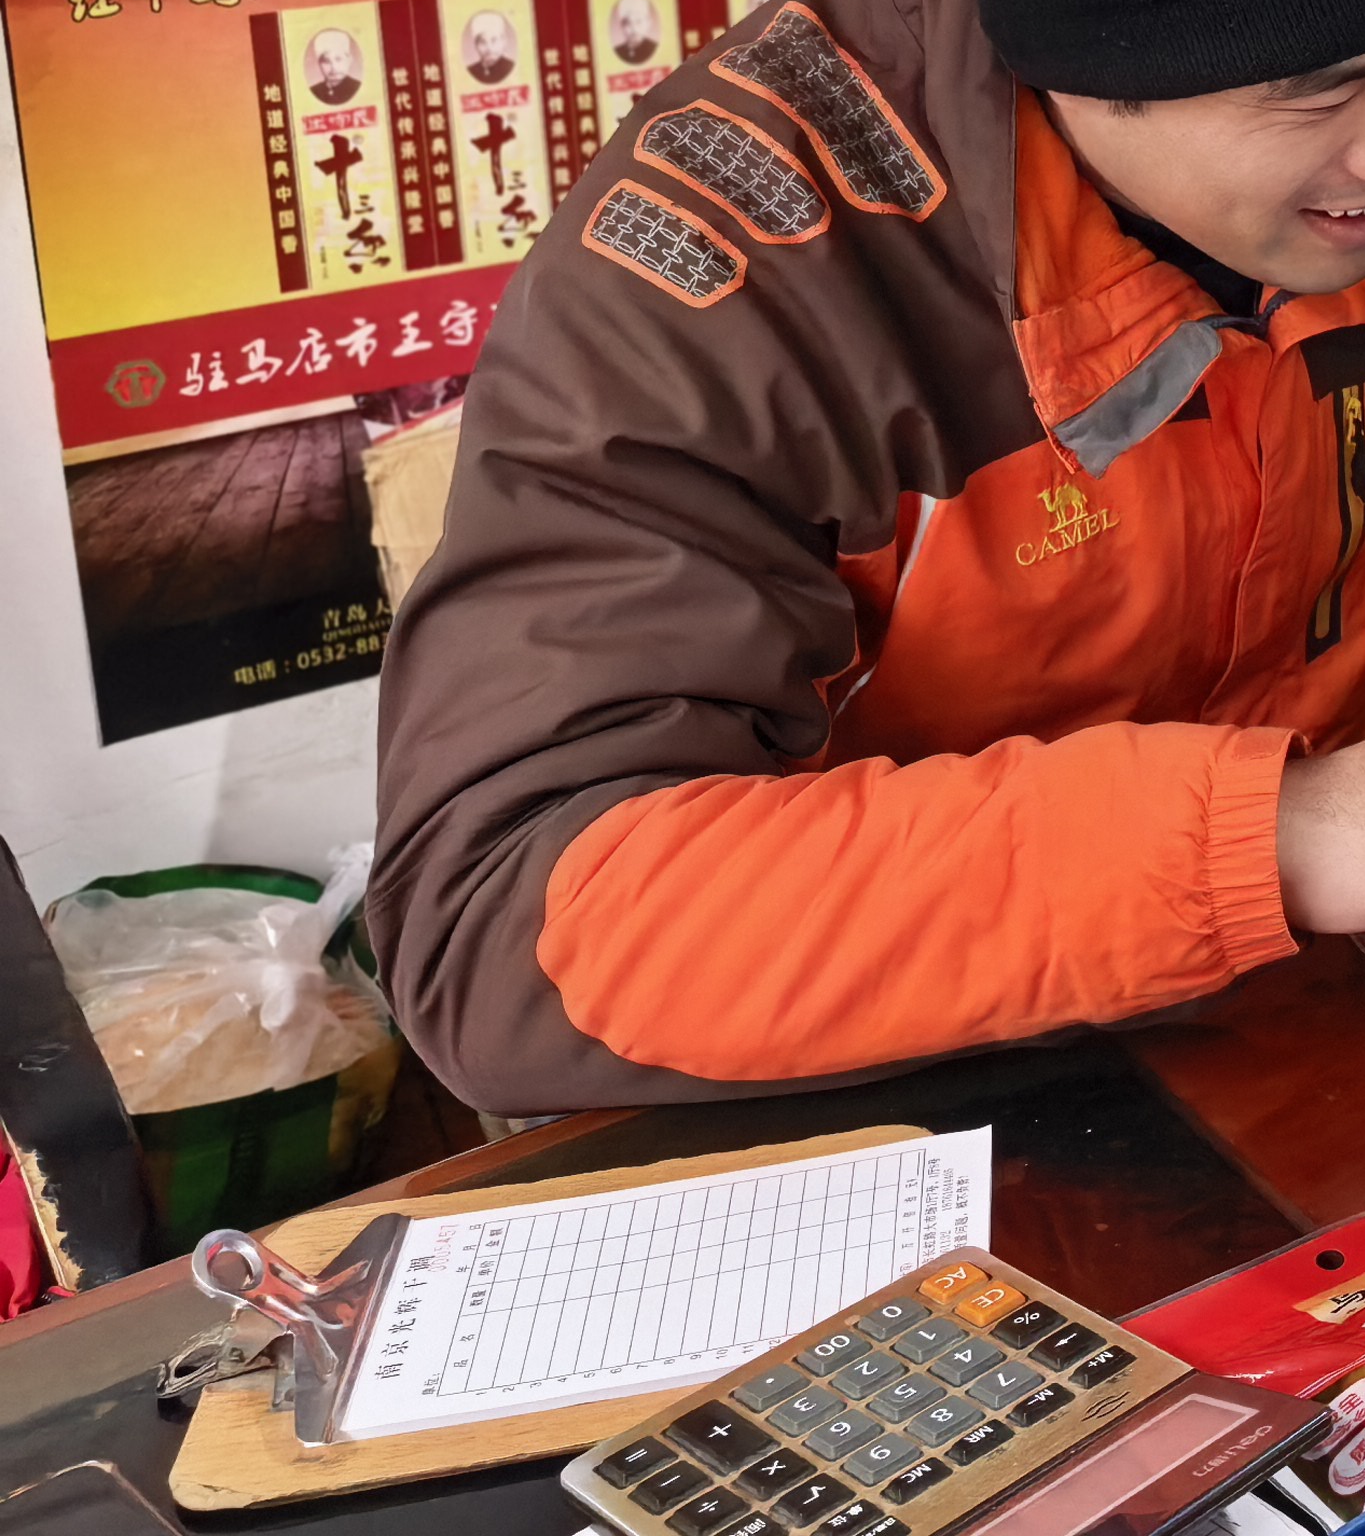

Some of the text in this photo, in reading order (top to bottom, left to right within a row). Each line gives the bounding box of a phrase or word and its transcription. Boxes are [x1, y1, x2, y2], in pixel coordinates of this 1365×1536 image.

[178, 297, 502, 398] 驻马店市王守
[1015, 508, 1121, 566] CAMEL
[934, 1265, 968, 1290] AC
[971, 1288, 1006, 1311] CE
